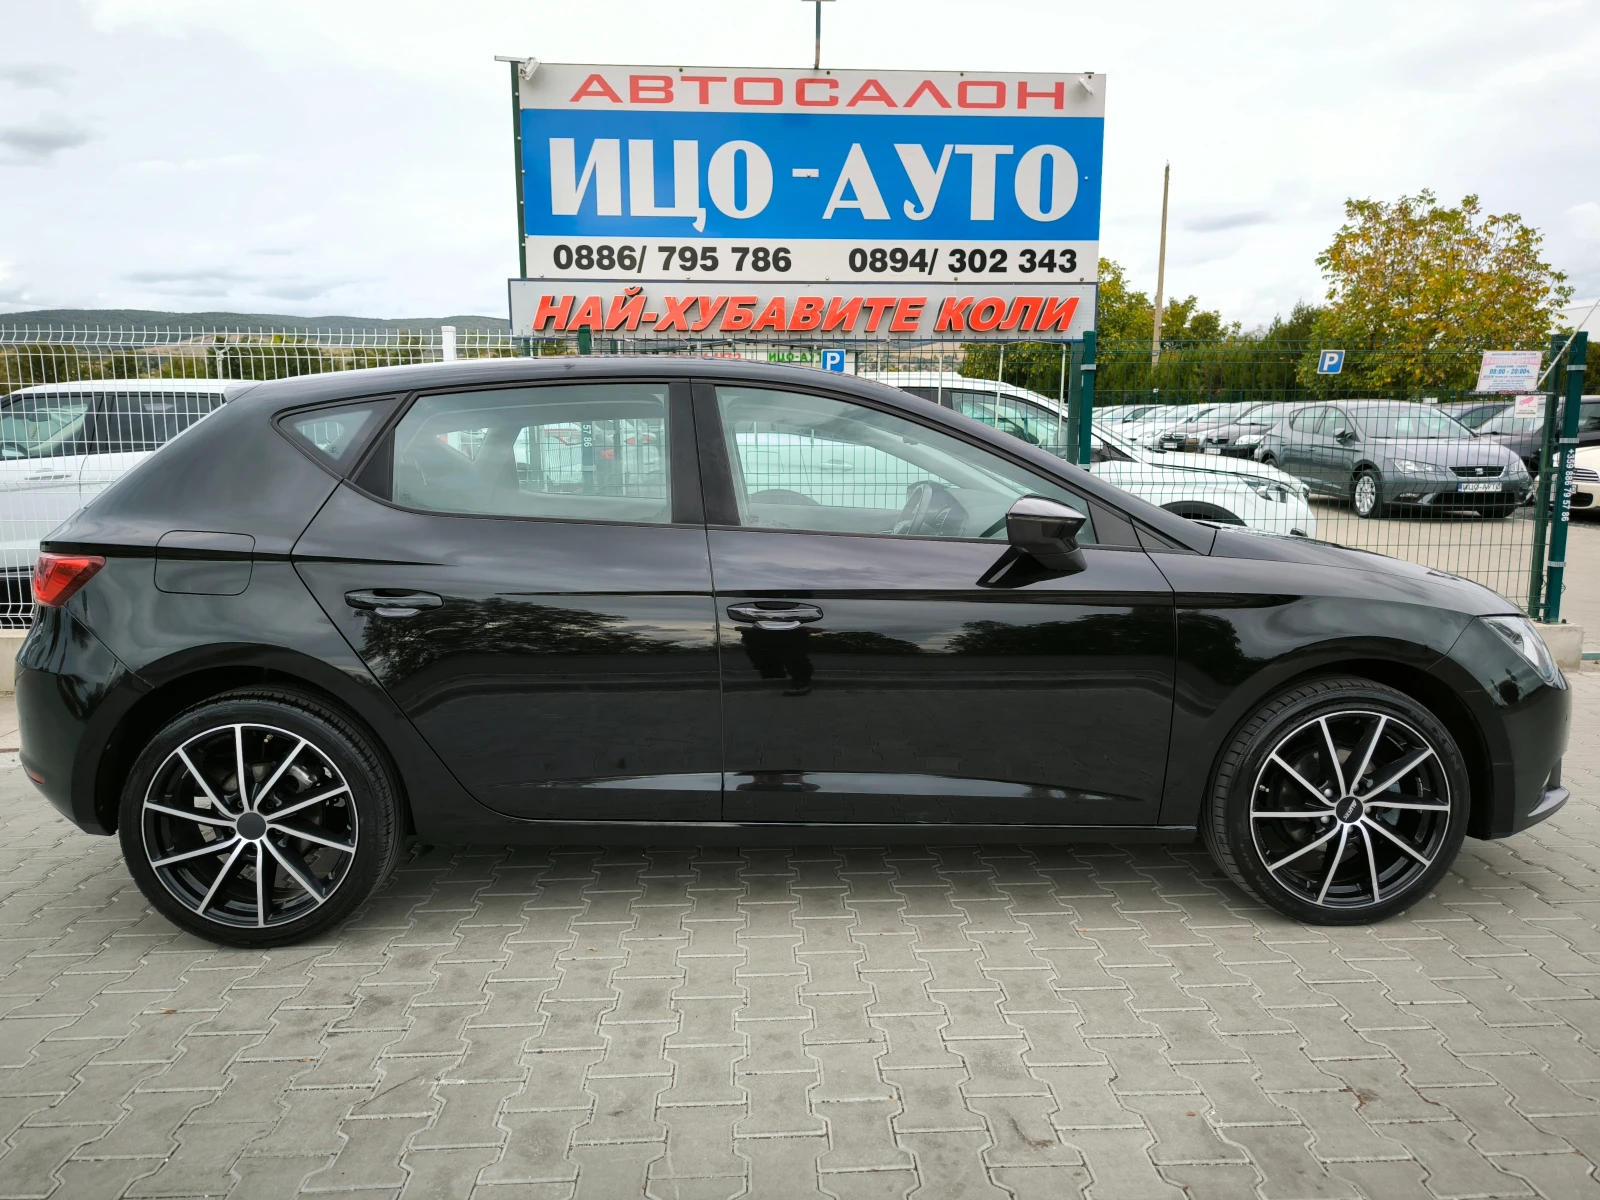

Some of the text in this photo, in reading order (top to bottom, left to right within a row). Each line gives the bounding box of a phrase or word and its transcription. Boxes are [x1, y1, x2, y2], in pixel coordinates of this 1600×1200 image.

[569, 73, 1064, 110] АВТОСАЛОН
[553, 244, 792, 274] 0886/ 795 786
[849, 247, 1077, 275] 0894/ 302 343
[531, 286, 1080, 332] НАЙ-ХУБАВИТЕ КОЛИ
[826, 352, 841, 371] P
[1323, 352, 1339, 371] P
[583, 424, 592, 448] 57 86
[1566, 448, 1575, 469] +359
[1565, 470, 1574, 486] 886
[1563, 487, 1572, 498] 79
[1562, 499, 1571, 510] 57
[1561, 511, 1570, 522] 86
